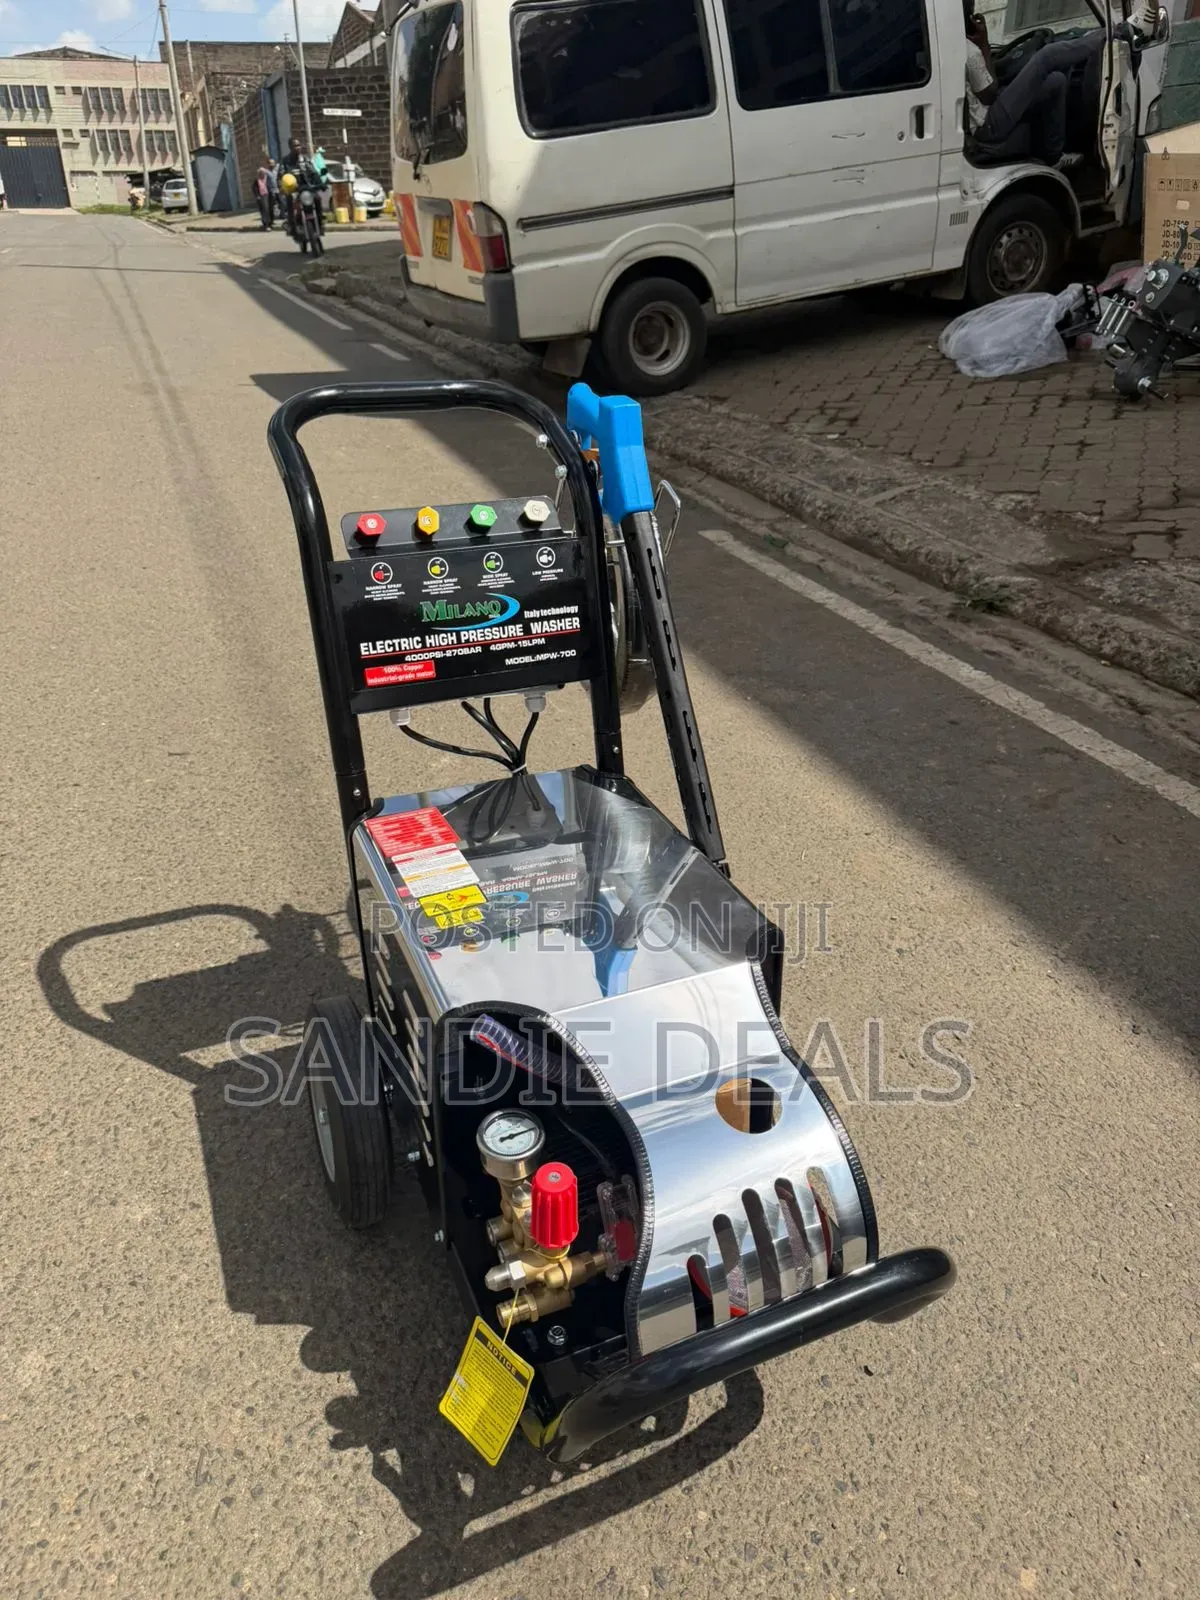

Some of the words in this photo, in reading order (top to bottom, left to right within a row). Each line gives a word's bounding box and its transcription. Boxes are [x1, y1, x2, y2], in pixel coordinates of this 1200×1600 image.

[524, 610, 539, 619] Italy
[540, 605, 579, 617] technology
[360, 636, 422, 655] ELECTRIC
[425, 631, 457, 648] HIGH
[461, 624, 524, 643] PRESSURE
[530, 617, 580, 634] WASHER
[405, 646, 482, 662] 4000PSI-270BAR
[490, 638, 546, 651] 4GPM-15LPM
[505, 649, 577, 665] MODEL:MPW-700
[403, 663, 424, 672] Copper
[486, 1339, 517, 1376] NOTICE
